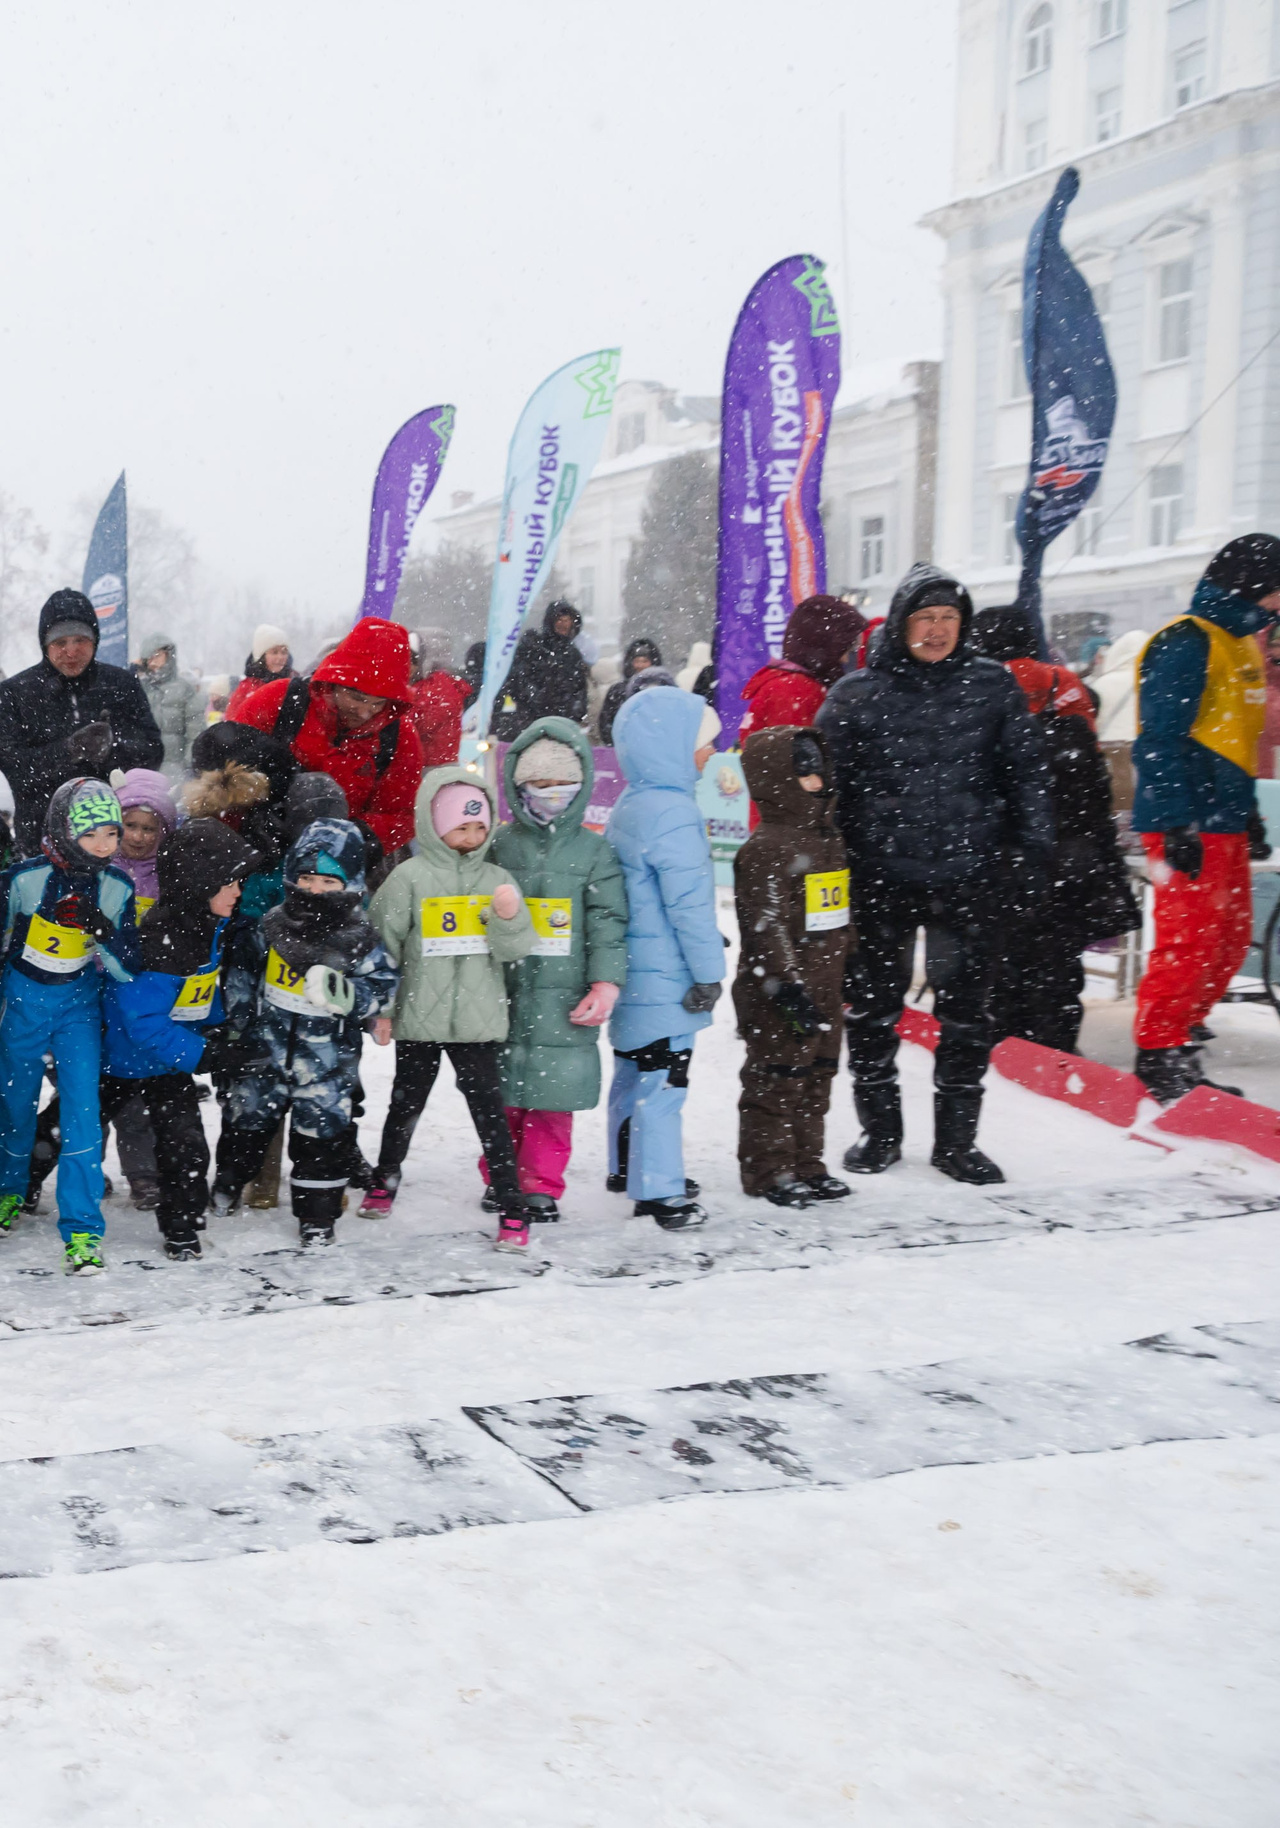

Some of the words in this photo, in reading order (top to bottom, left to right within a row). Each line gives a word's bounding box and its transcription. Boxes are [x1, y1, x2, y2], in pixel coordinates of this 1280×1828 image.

[768, 338, 802, 451] КУБОК
[534, 424, 560, 505] КУБОК
[820, 886, 841, 907] 10
[441, 911, 457, 932] 8
[45, 936, 60, 954] 2
[275, 963, 301, 988] 19
[189, 984, 214, 1004] 14
